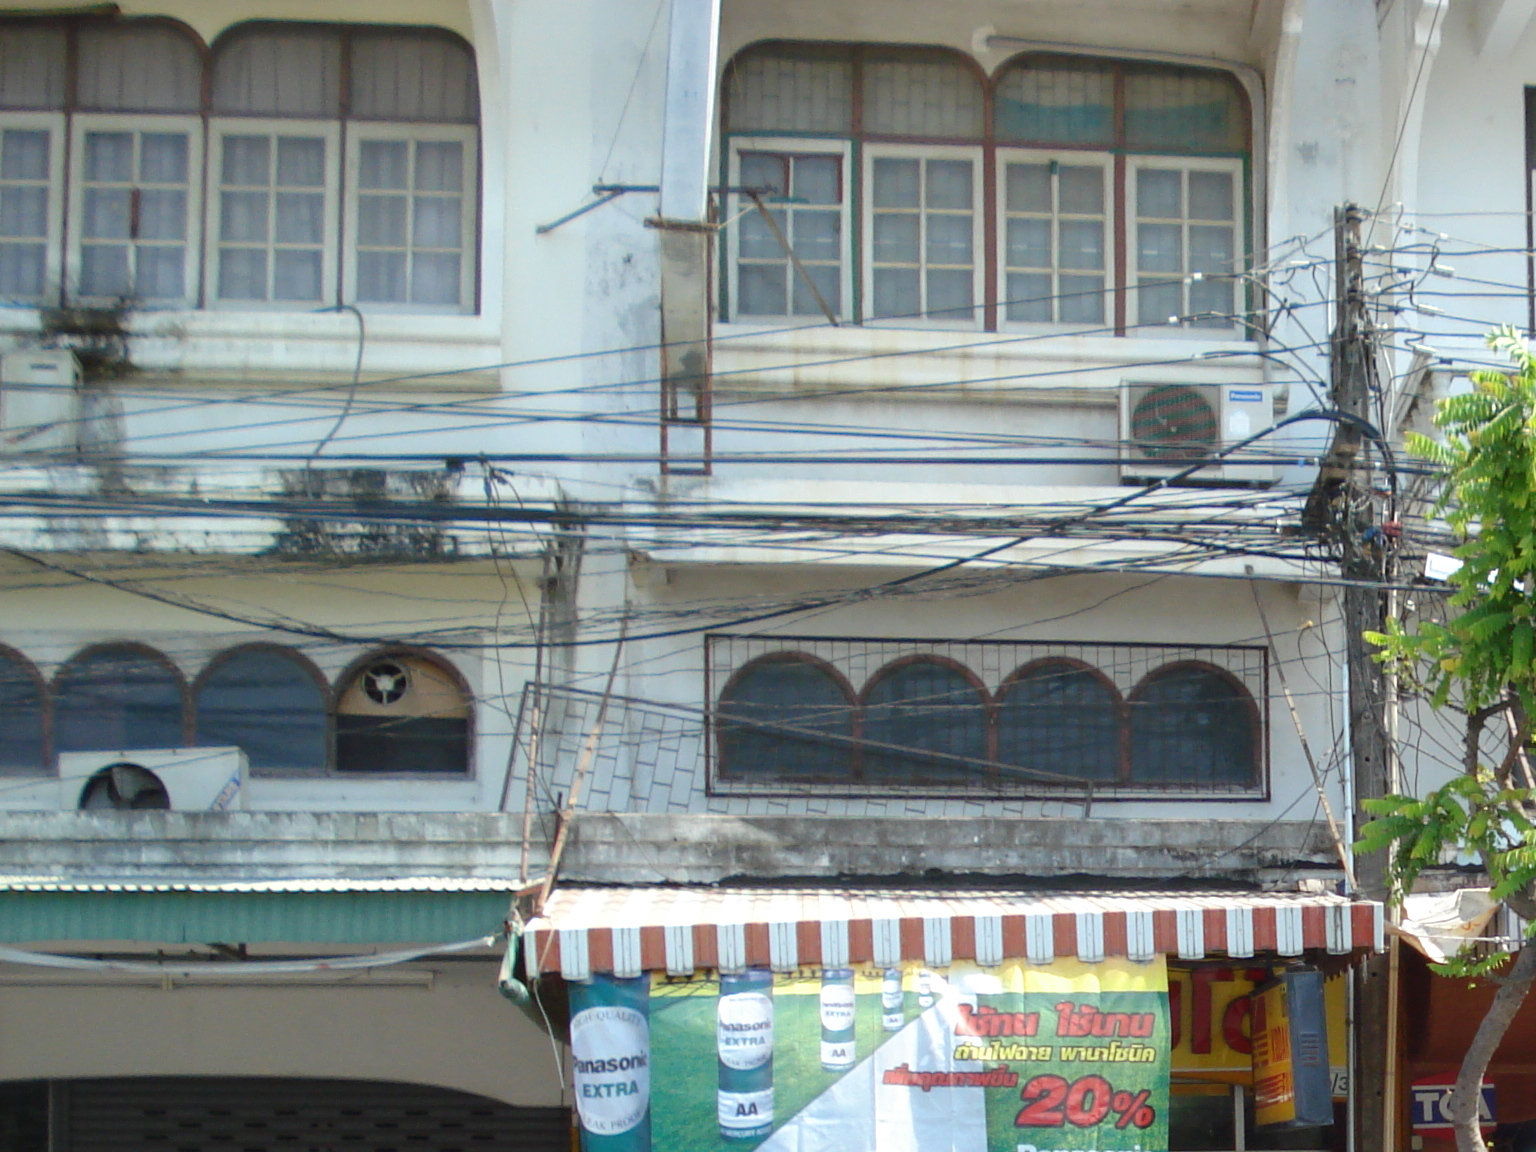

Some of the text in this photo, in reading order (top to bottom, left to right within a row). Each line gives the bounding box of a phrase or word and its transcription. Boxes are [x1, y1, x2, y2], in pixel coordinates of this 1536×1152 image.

[955, 1001, 1040, 1037] ใช้ทน
[1055, 1001, 1155, 1038] ใช้นาน
[832, 1049, 847, 1057] AA
[954, 1041, 1156, 1063] ถ่านไฟฉาย พานาโซนิค
[582, 1081, 640, 1099] EXTRA
[735, 1103, 759, 1117] AA
[1014, 1074, 1156, 1129] 20%
